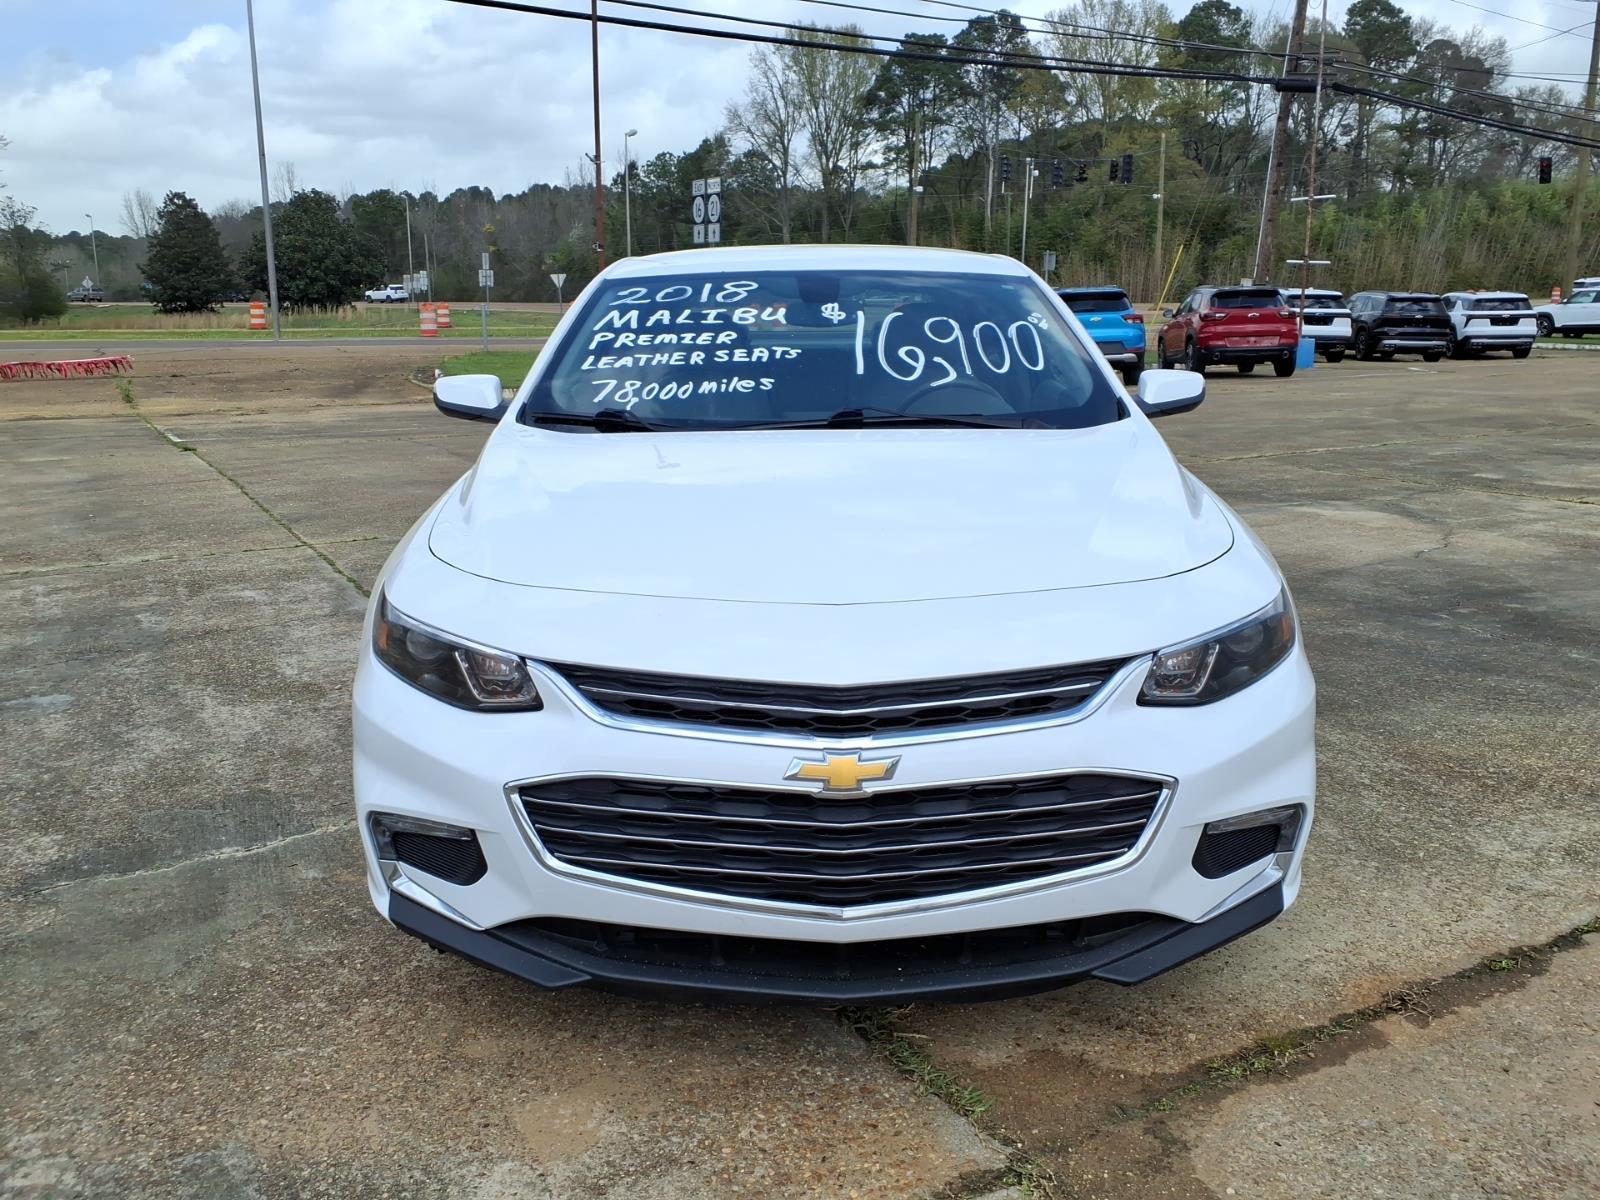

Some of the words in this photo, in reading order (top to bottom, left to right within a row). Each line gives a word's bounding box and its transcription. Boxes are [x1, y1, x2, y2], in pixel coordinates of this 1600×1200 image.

[695, 202, 702, 218] 16
[710, 200, 718, 217] 21
[609, 281, 759, 306] 2018
[594, 307, 787, 331] MALIBU
[588, 331, 738, 350] PREMIER
[581, 350, 705, 371] LEATHER
[591, 379, 694, 410] 78,000
[699, 376, 775, 395] miles
